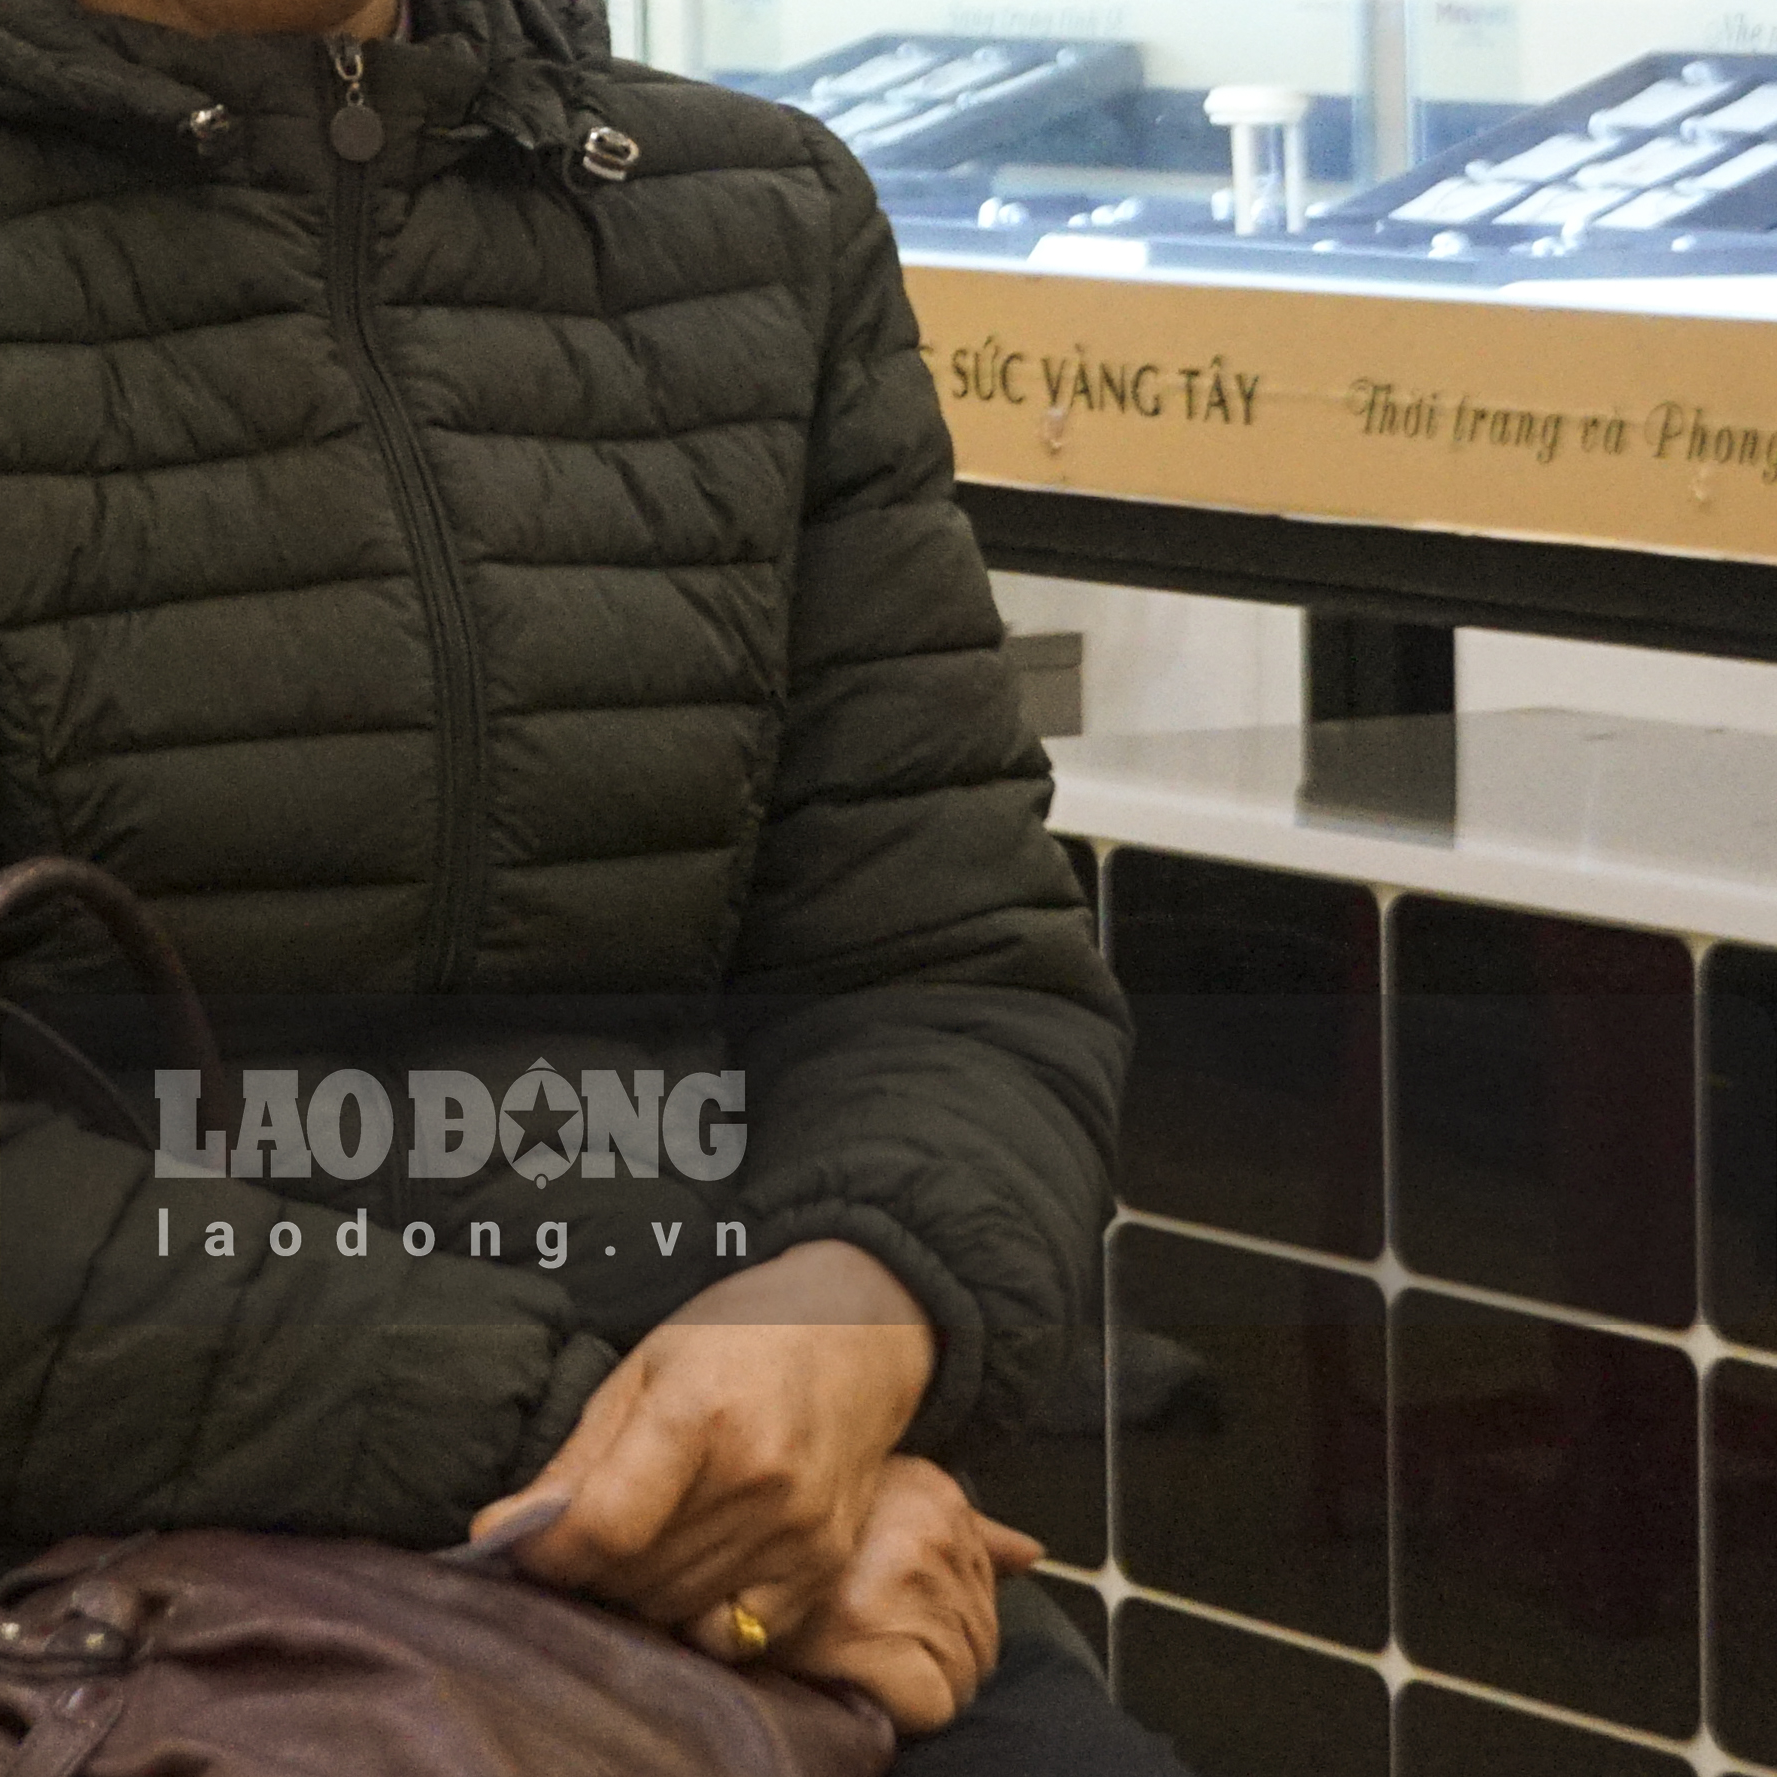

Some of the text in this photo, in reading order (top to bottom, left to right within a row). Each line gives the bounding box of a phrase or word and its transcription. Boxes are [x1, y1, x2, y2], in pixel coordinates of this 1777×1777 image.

[950, 334, 1260, 426] SỨC VÀNG TÂY
[1450, 392, 1565, 465] trang
